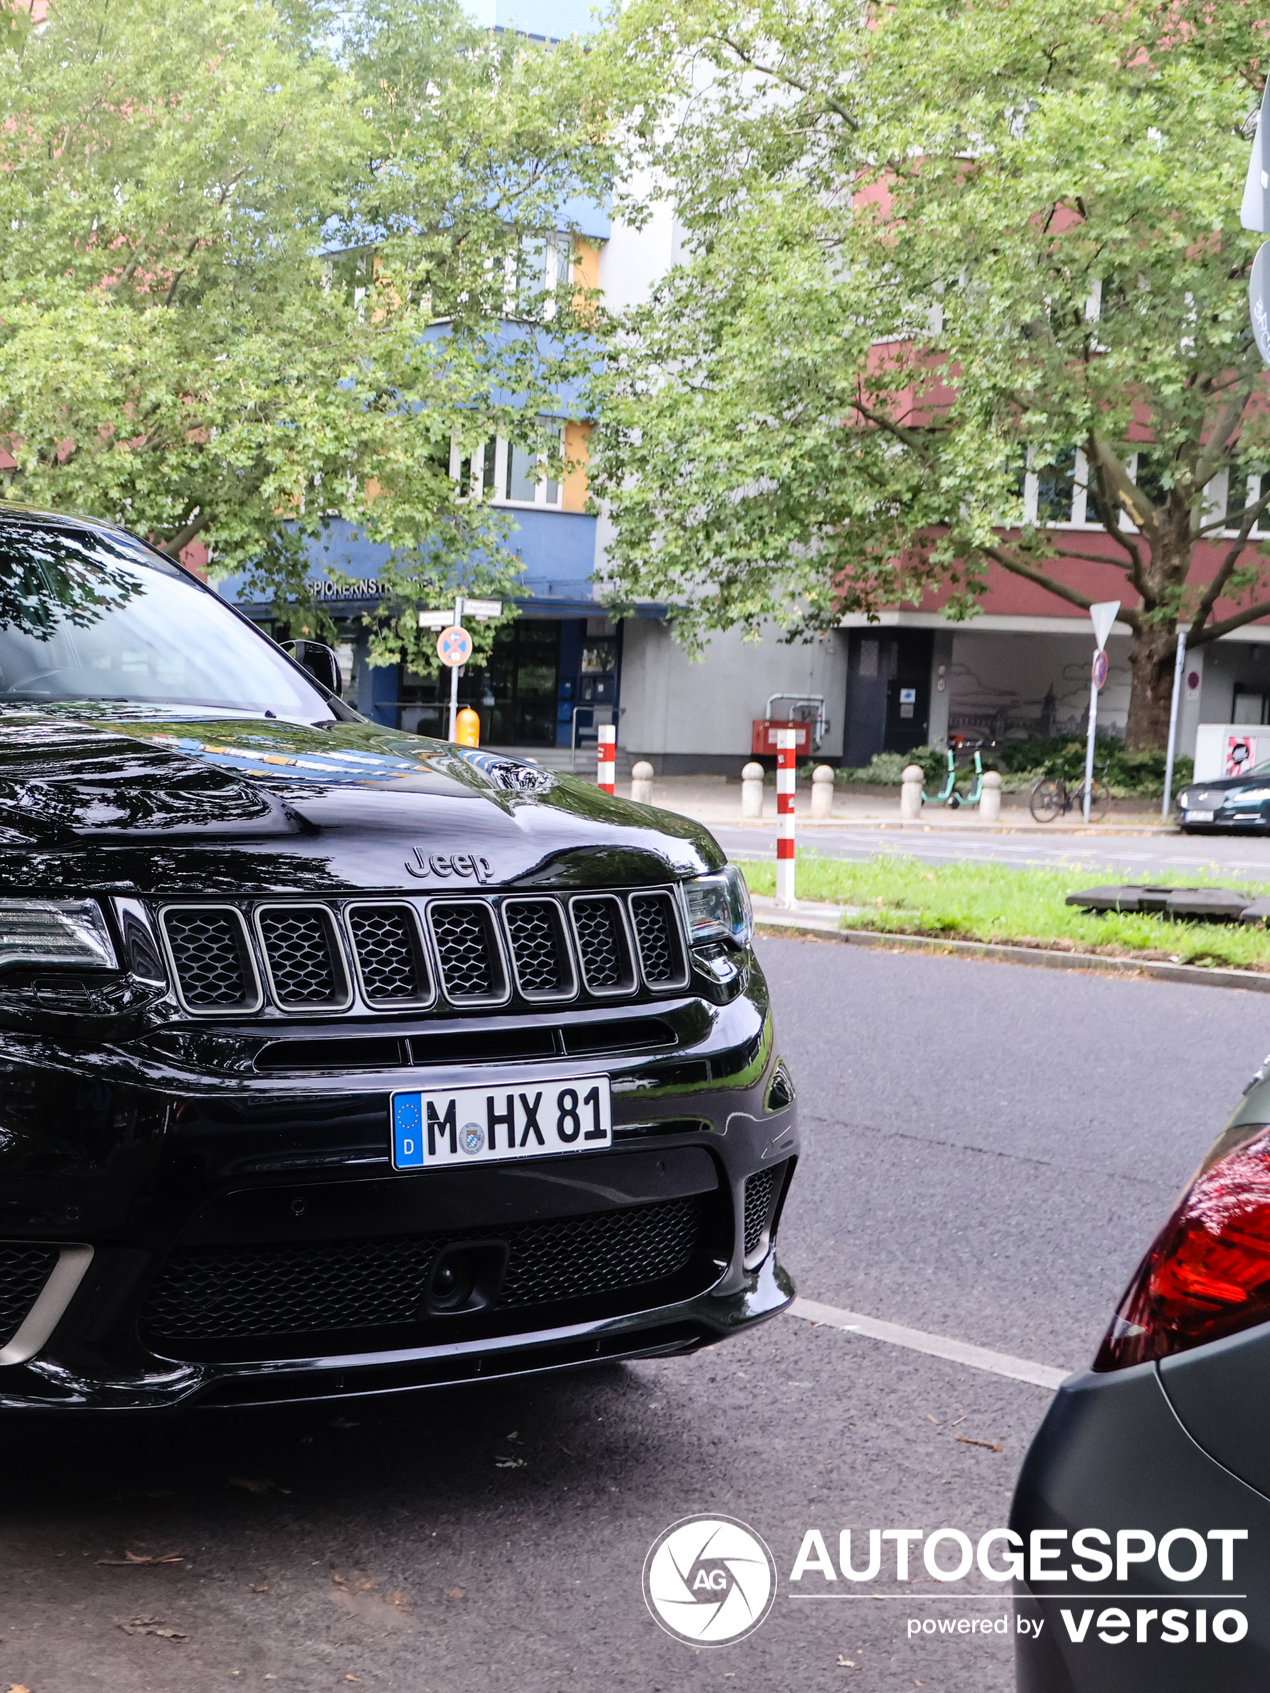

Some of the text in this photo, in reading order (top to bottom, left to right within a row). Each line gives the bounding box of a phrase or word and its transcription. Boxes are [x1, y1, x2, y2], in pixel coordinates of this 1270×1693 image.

[404, 845, 495, 884] Jeep
[426, 1098, 458, 1156] M
[486, 1091, 546, 1150] HX
[557, 1086, 608, 1143] 81
[403, 1139, 415, 1155] D
